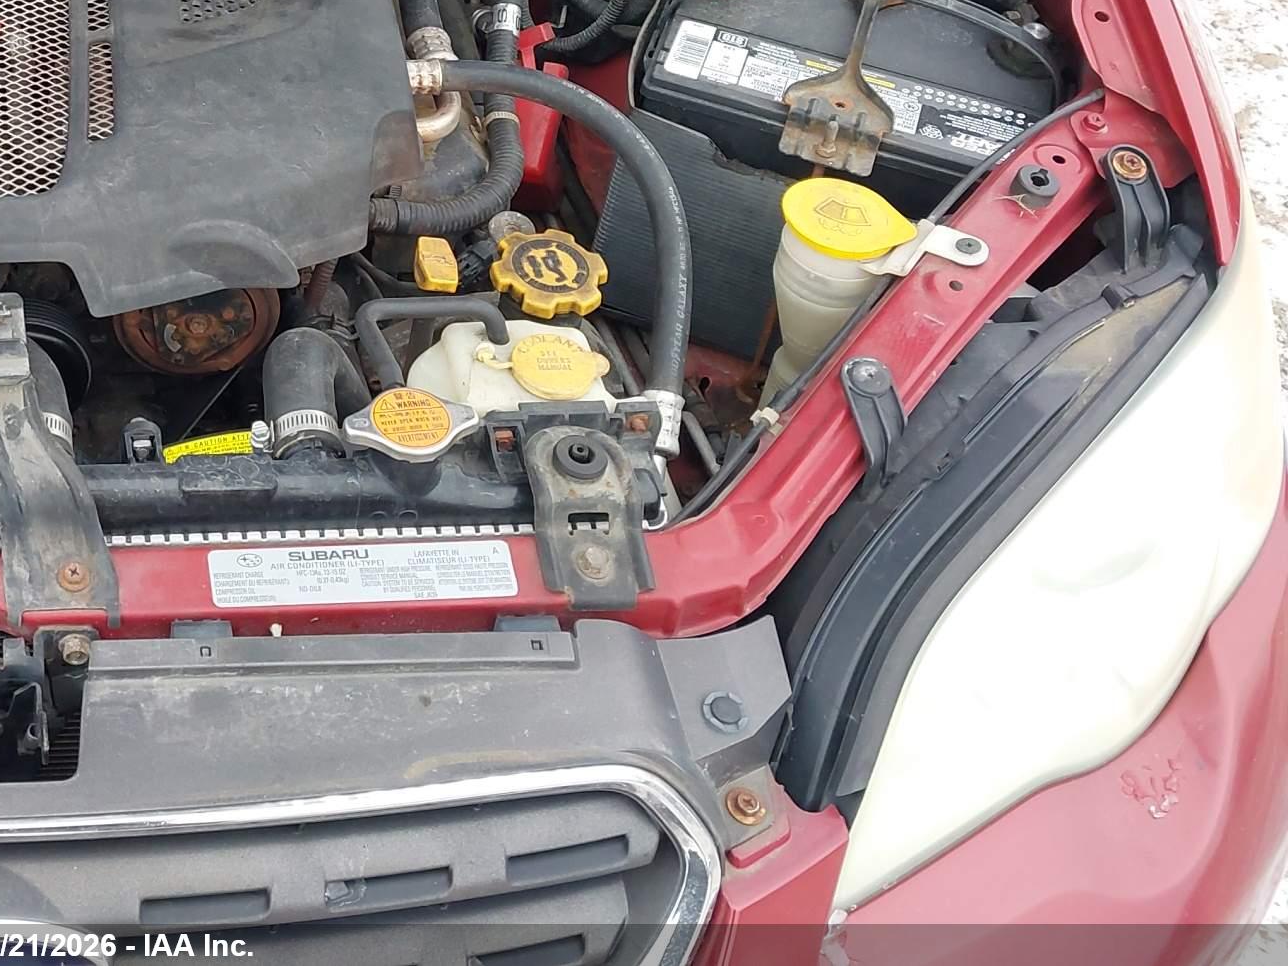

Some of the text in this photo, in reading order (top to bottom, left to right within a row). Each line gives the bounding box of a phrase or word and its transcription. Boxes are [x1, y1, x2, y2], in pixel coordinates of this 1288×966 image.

[676, 273, 688, 319] GALAXY
[395, 398, 432, 410] WARNING
[193, 437, 229, 450] CAUTION
[288, 548, 369, 562] SUBARU
[492, 546, 500, 555] A
[270, 562, 285, 571] AIR
[287, 561, 346, 570] CONDITIONER
[407, 556, 456, 566] CLIMATISEUR
